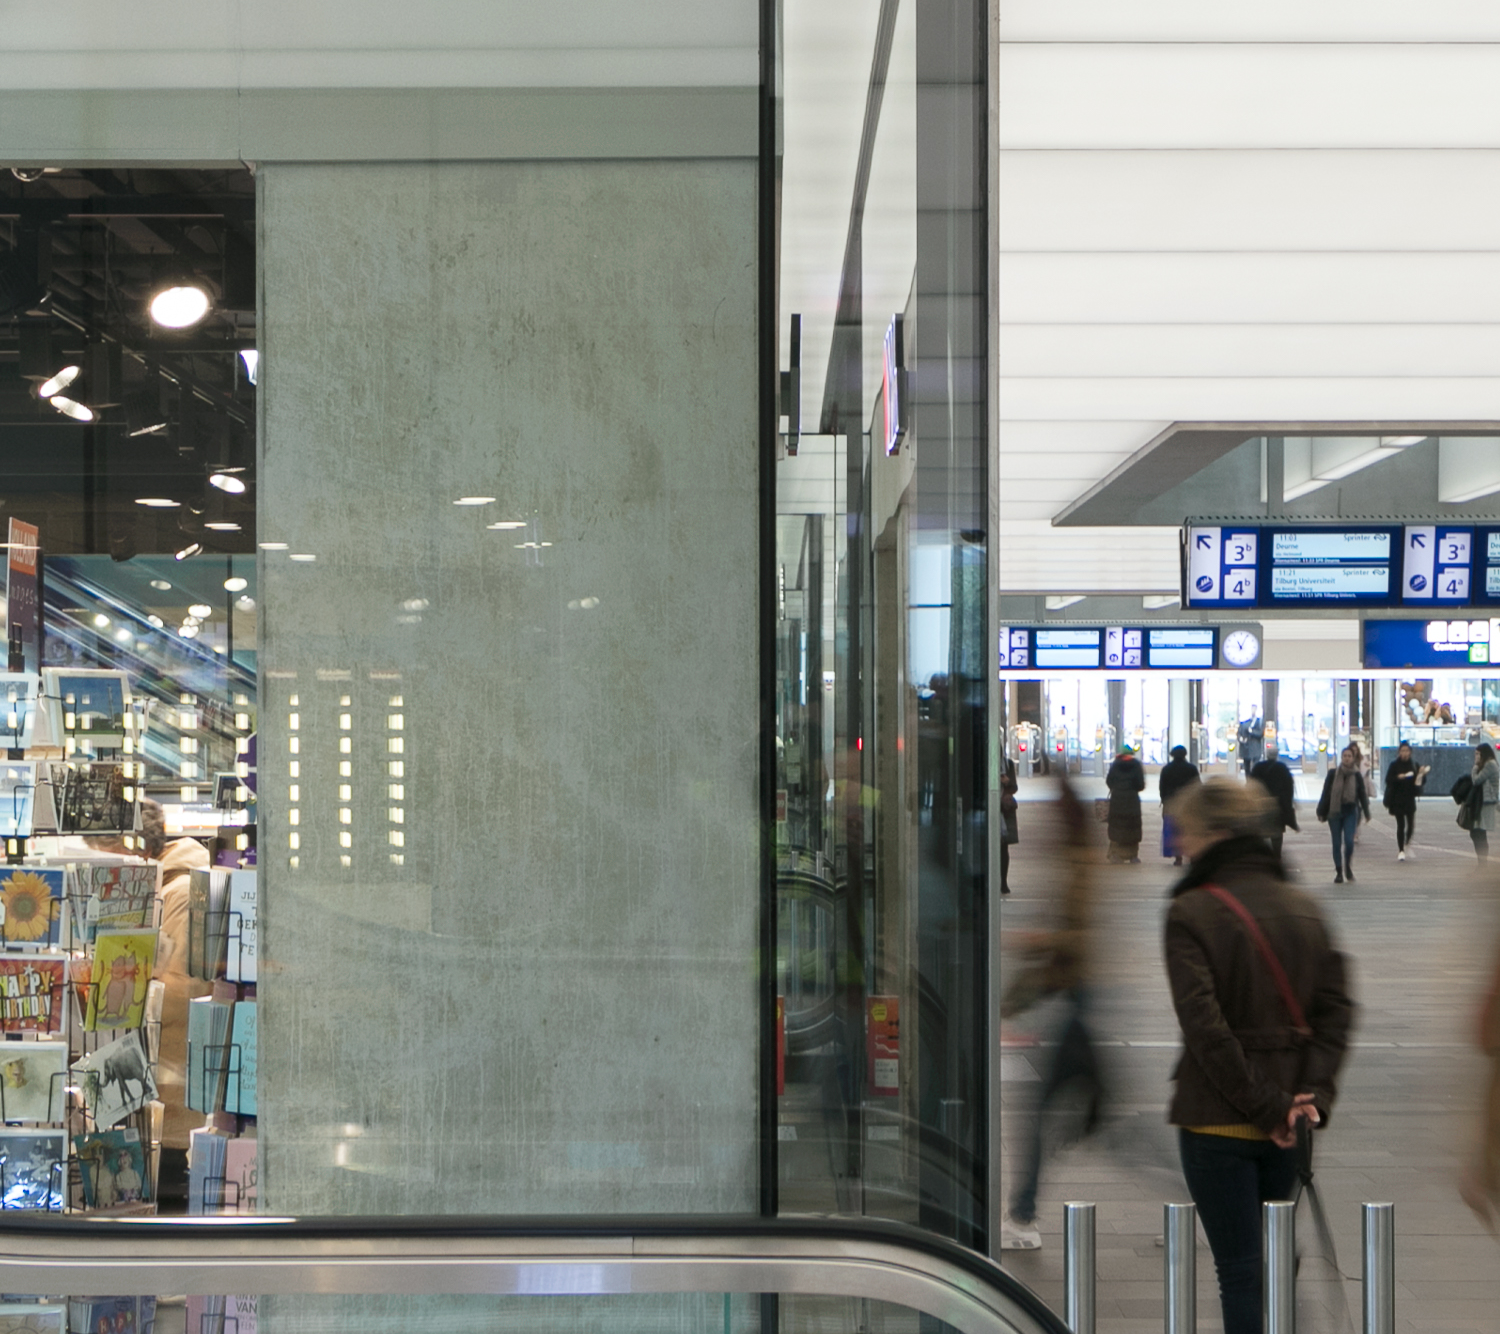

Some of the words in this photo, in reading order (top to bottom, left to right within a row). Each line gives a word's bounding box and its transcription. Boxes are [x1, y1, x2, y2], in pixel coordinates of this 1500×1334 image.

[1343, 534, 1370, 542] Sprinter
[1342, 569, 1370, 578] Sprinter
[236, 1302, 257, 1314] VAN
